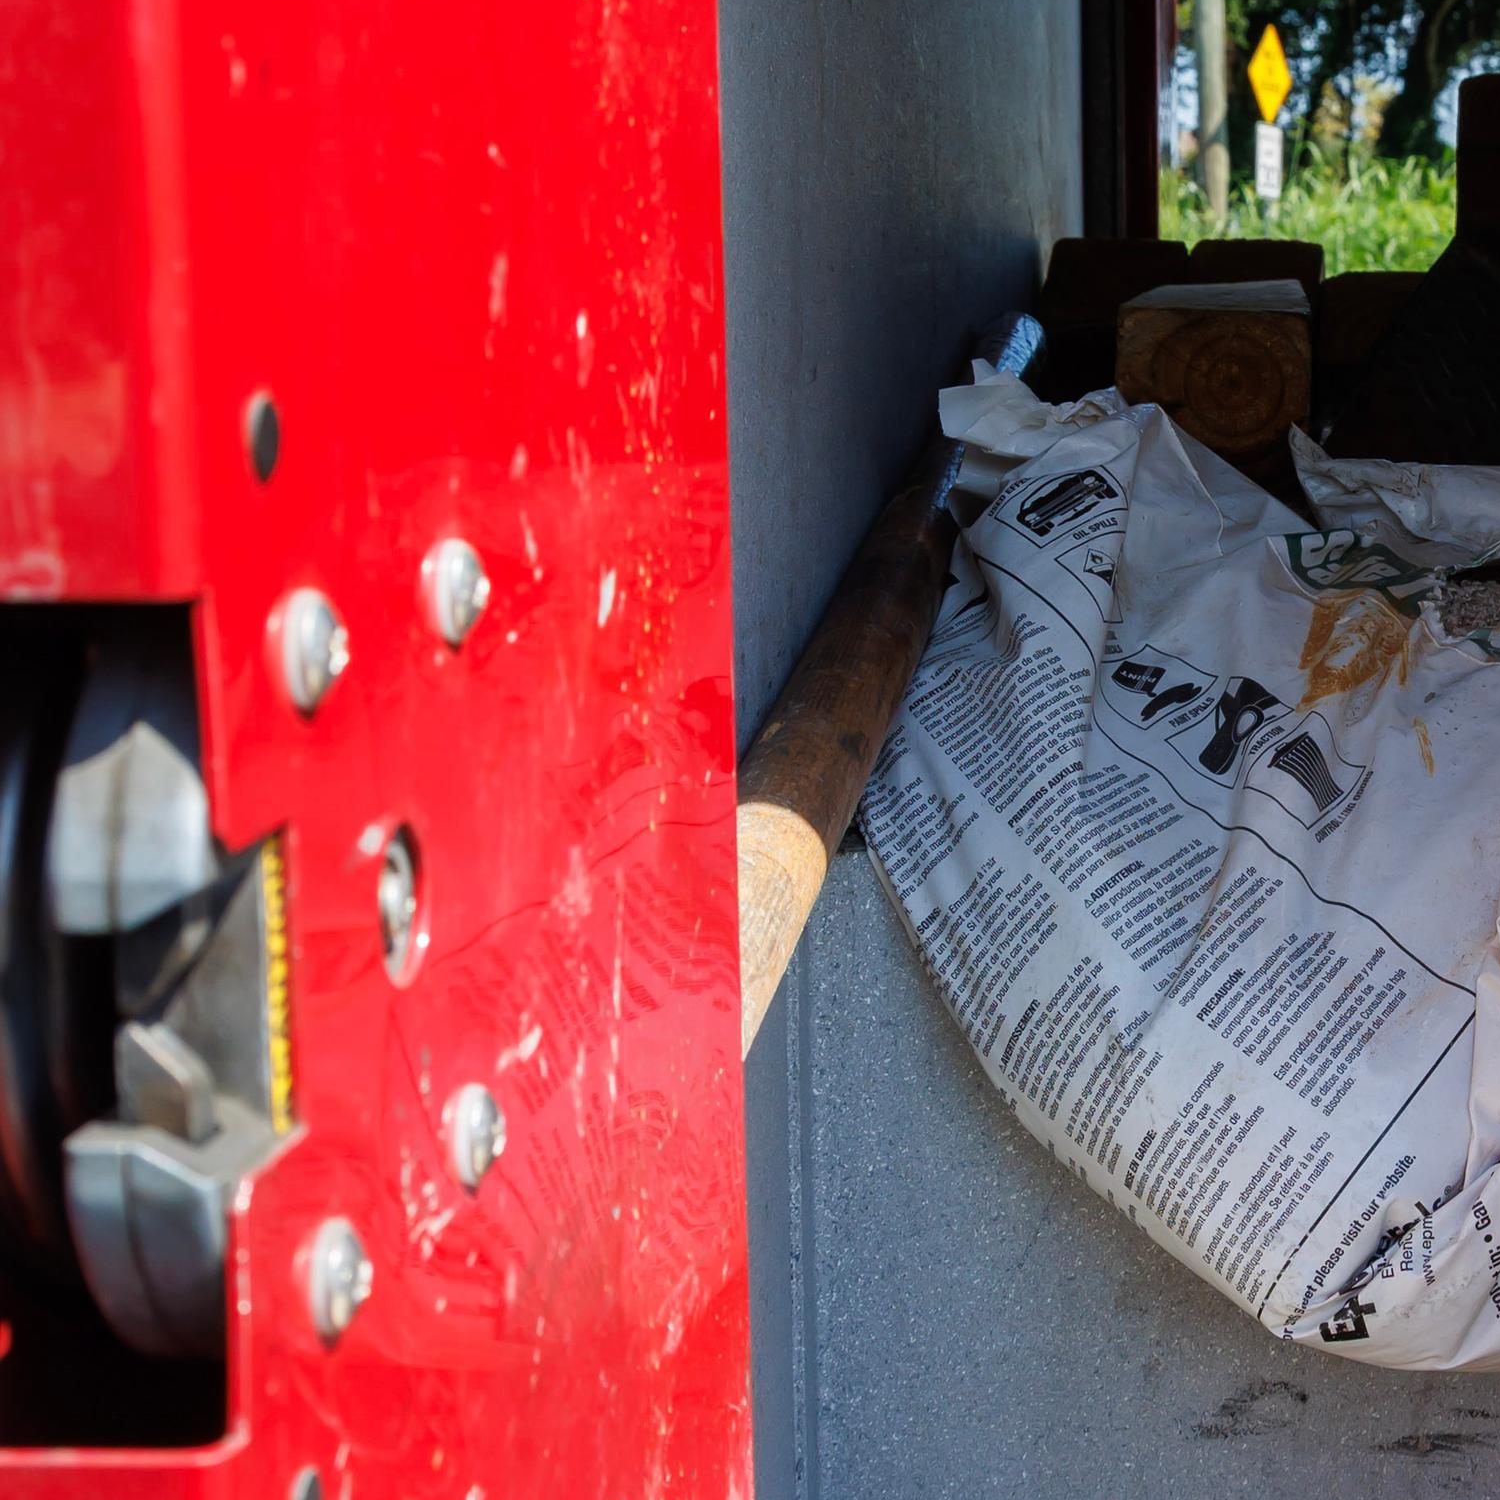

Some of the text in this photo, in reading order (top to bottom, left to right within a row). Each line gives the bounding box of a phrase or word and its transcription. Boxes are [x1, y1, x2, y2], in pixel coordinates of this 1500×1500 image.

[1071, 516, 1118, 541] OIL SPILLS
[1191, 694, 1215, 718] SPILLS
[1246, 723, 1284, 756] TRACTION
[1006, 785, 1049, 828] PRIMEROS
[1065, 973, 1076, 982] à
[1070, 963, 1085, 977] de
[1079, 954, 1092, 966] la
[1044, 980, 1072, 1013] exposer
[1195, 964, 1246, 1022] PRECAUCIÓN:
[1207, 930, 1299, 1031] Materiales incompatibles: Los
[1032, 1011, 1049, 1031] vous
[1254, 953, 1349, 1066] soluciones fuertemente básicas.
[1272, 944, 1386, 1081] Este producto es un absorbente y puede
[999, 997, 1041, 1066] AVERTISSEMENT:
[1021, 1028, 1037, 1050] peut
[1284, 981, 1374, 1090] tomar las características de los
[1297, 966, 1408, 1099] materiales absorbidos. Consulte la hoja
[1010, 1045, 1027, 1075] produit
[1055, 1004, 1119, 1102] www.P65Warnings.ca.gov.
[1178, 1058, 1225, 1119] Les composés
[1321, 1073, 1357, 1117] absorbido.
[1133, 1127, 1158, 1162] GARDE:
[1127, 1158, 1140, 1173] EN
[1310, 1149, 1417, 1288] please visit our website.
